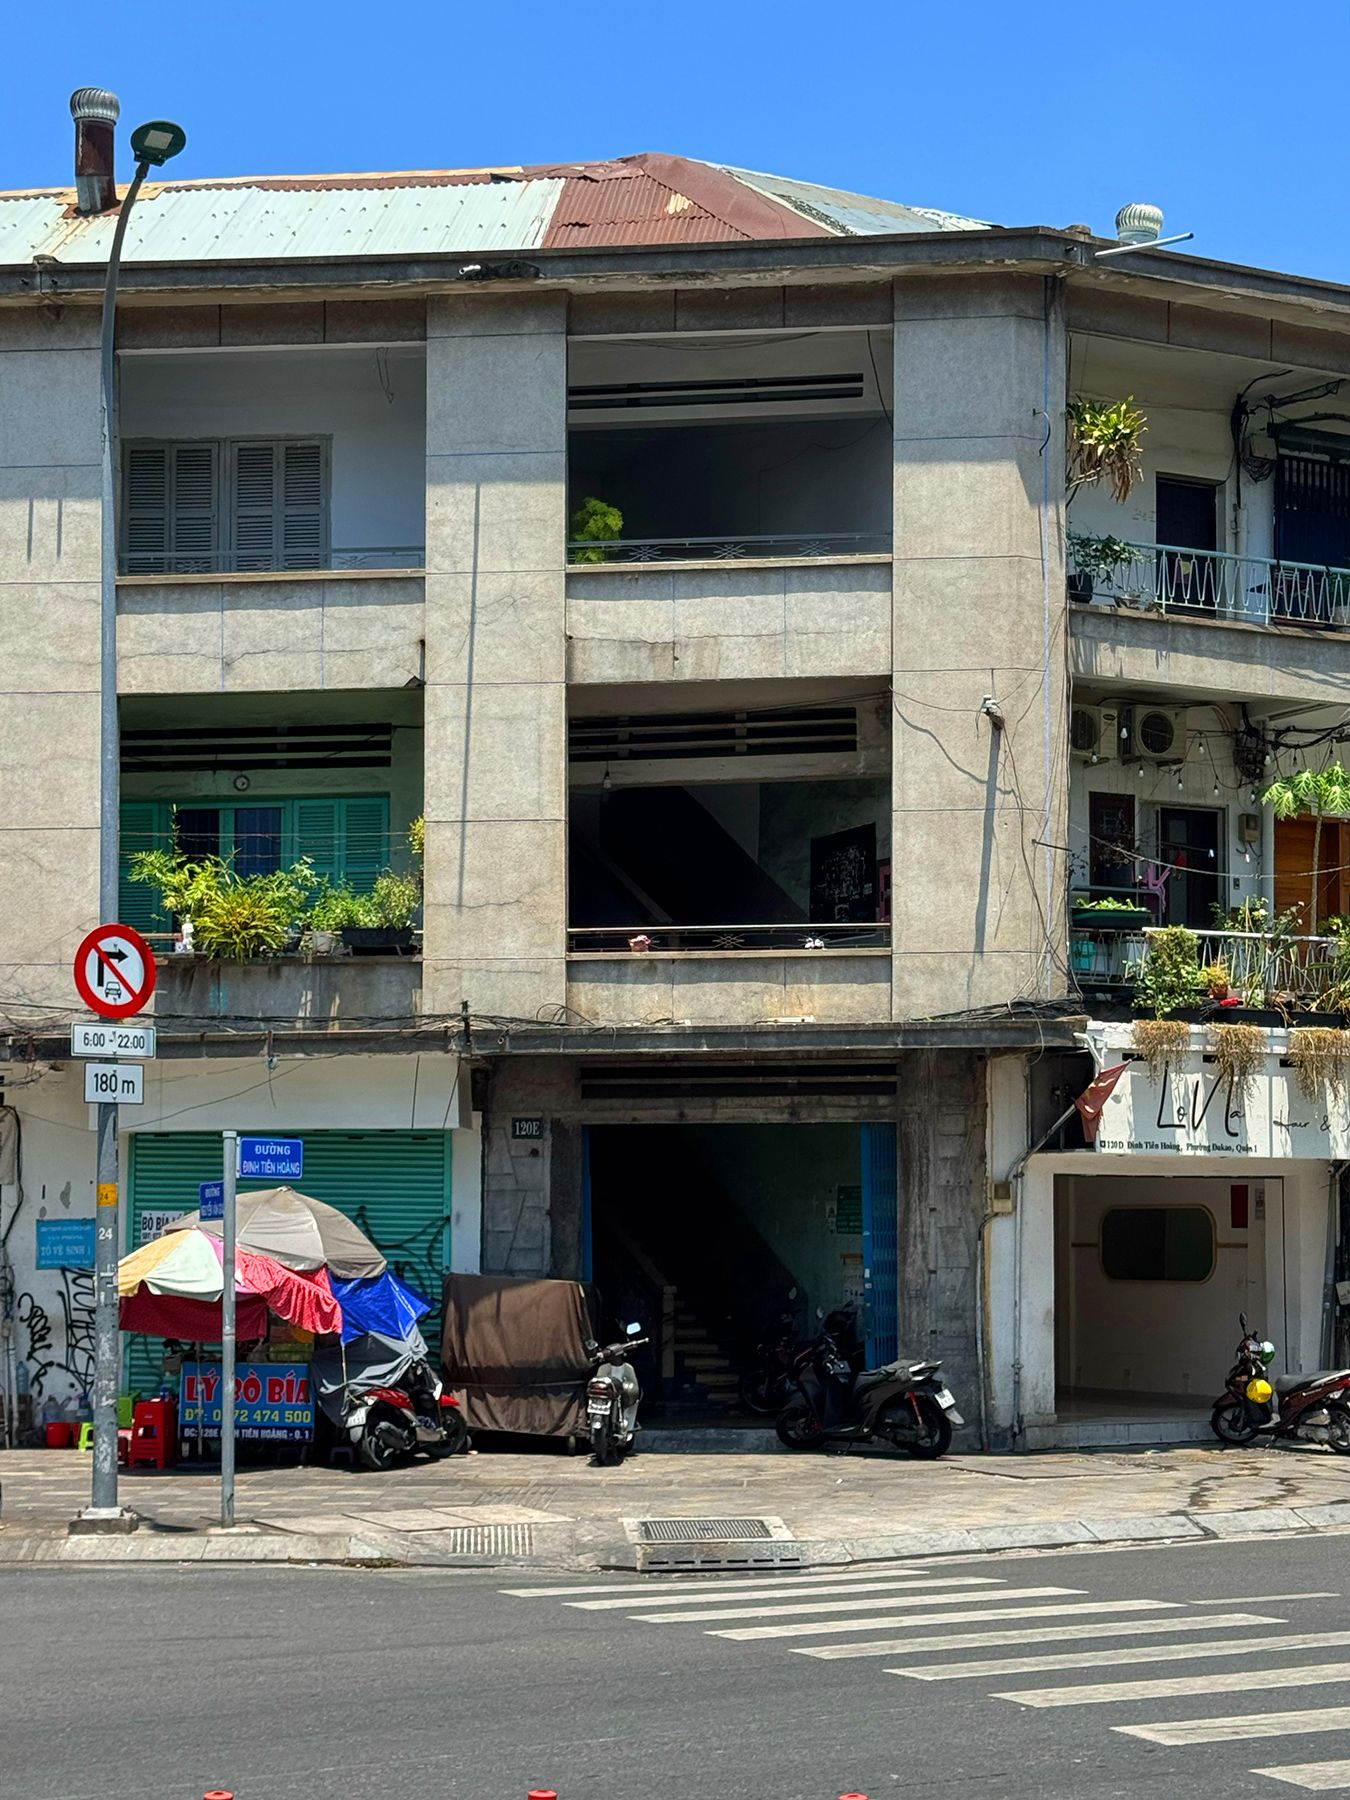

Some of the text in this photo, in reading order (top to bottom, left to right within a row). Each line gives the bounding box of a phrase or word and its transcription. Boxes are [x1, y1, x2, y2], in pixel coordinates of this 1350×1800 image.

[83, 1032, 105, 1047] 6:00
[117, 1034, 145, 1049] 22:00
[94, 1073, 135, 1094] 180 m
[515, 1121, 540, 1136] 120E
[1320, 1115, 1331, 1131] &
[255, 1142, 291, 1155] ĐƯỜNG
[242, 1160, 260, 1173] ĐINH
[276, 1159, 300, 1174] HOÀNG
[142, 1212, 154, 1231] BÒ
[98, 1227, 113, 1240] 24
[185, 1368, 220, 1402] LÝ
[266, 1369, 312, 1404] BÍA
[213, 1409, 249, 1422] 072
[253, 1410, 279, 1422] 474
[284, 1410, 312, 1423] 500
